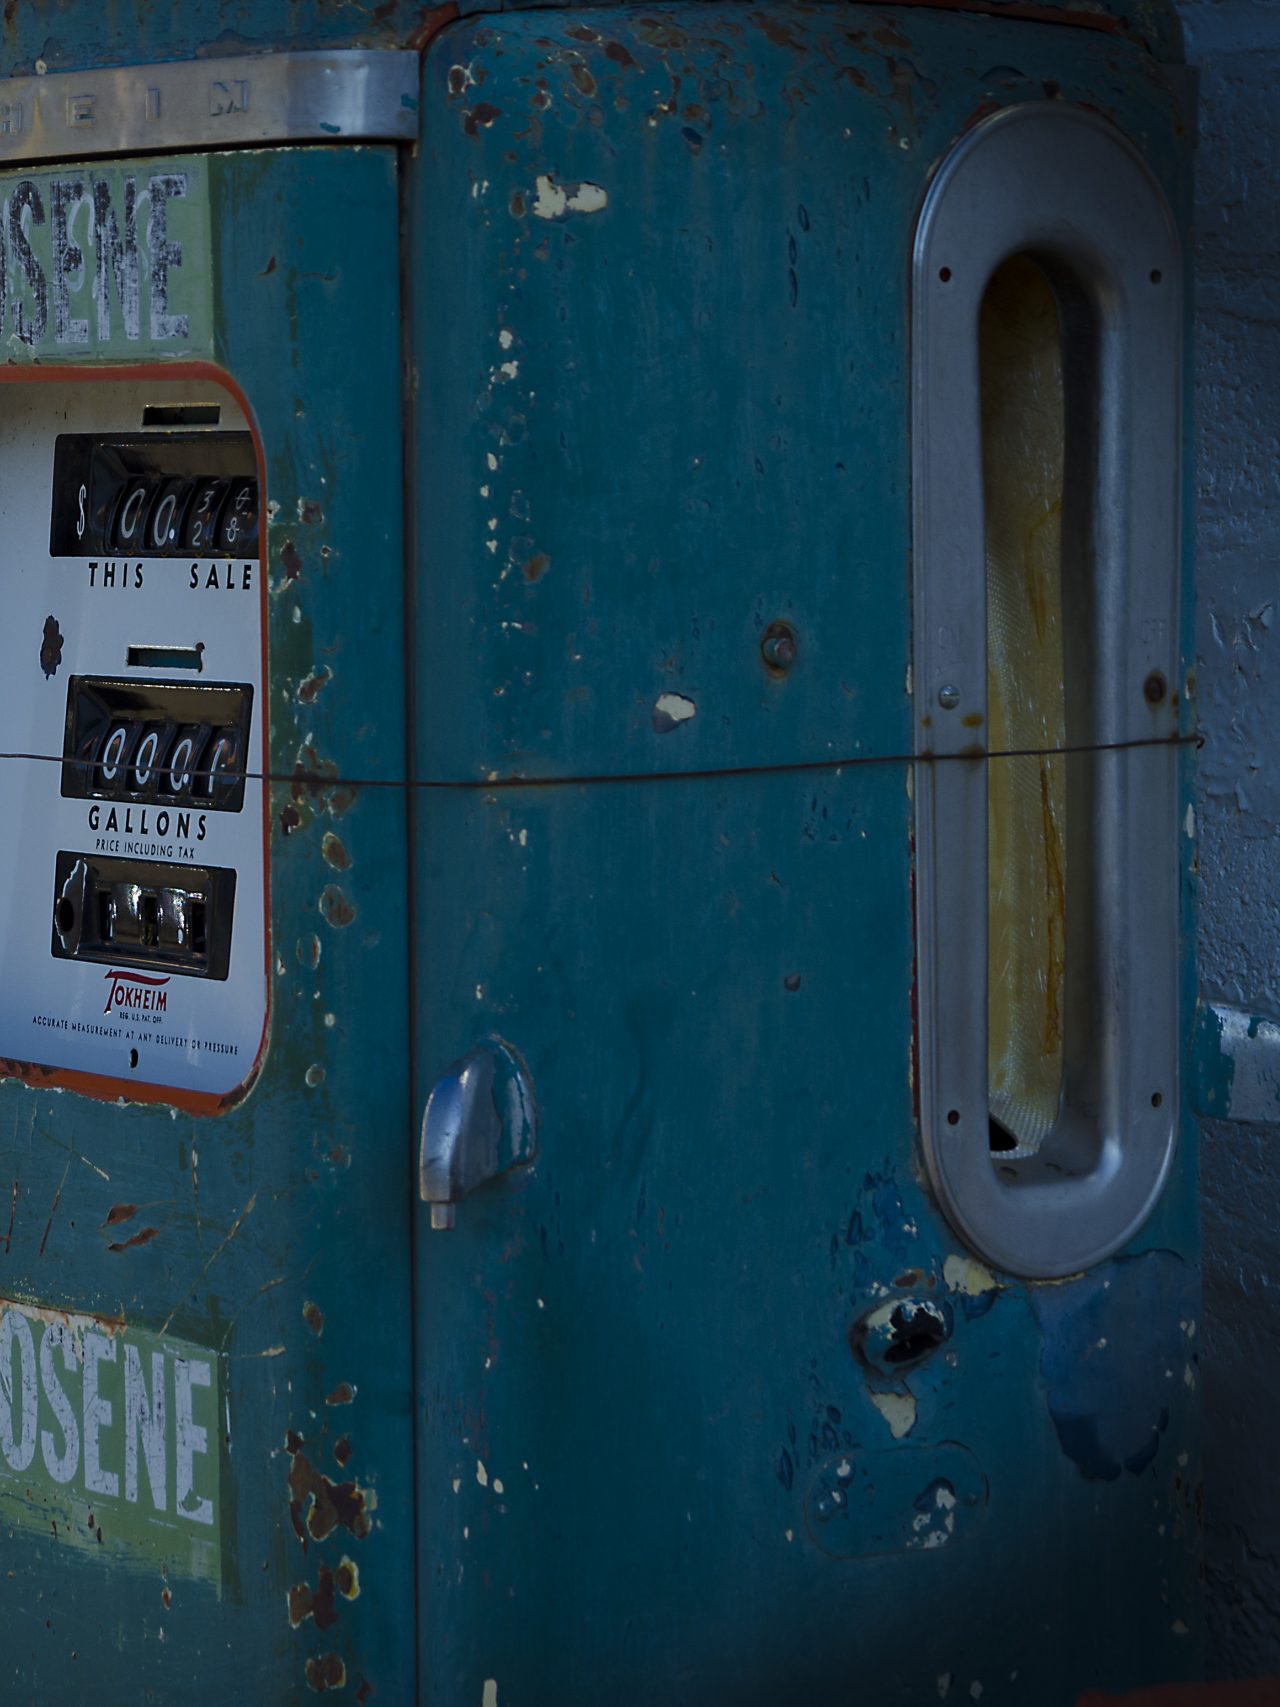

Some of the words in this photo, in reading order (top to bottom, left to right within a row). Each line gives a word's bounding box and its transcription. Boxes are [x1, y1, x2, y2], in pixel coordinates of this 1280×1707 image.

[88, 562, 144, 589] THIS
[189, 563, 252, 590] SALE
[88, 804, 207, 841] GALLONS
[95, 838, 120, 852] PRICE
[123, 842, 173, 857] INCLUDING
[178, 846, 195, 859] TAX
[104, 969, 170, 1014] TOKHEIM
[32, 1016, 68, 1030] ACCURATE
[71, 1022, 121, 1038] MEASUREMENT
[125, 1030, 135, 1040] AT
[138, 1032, 152, 1043] ANY
[155, 1034, 188, 1048] DELIVERY
[191, 1040, 201, 1050] OR
[204, 1041, 238, 1056] PRESSURE
